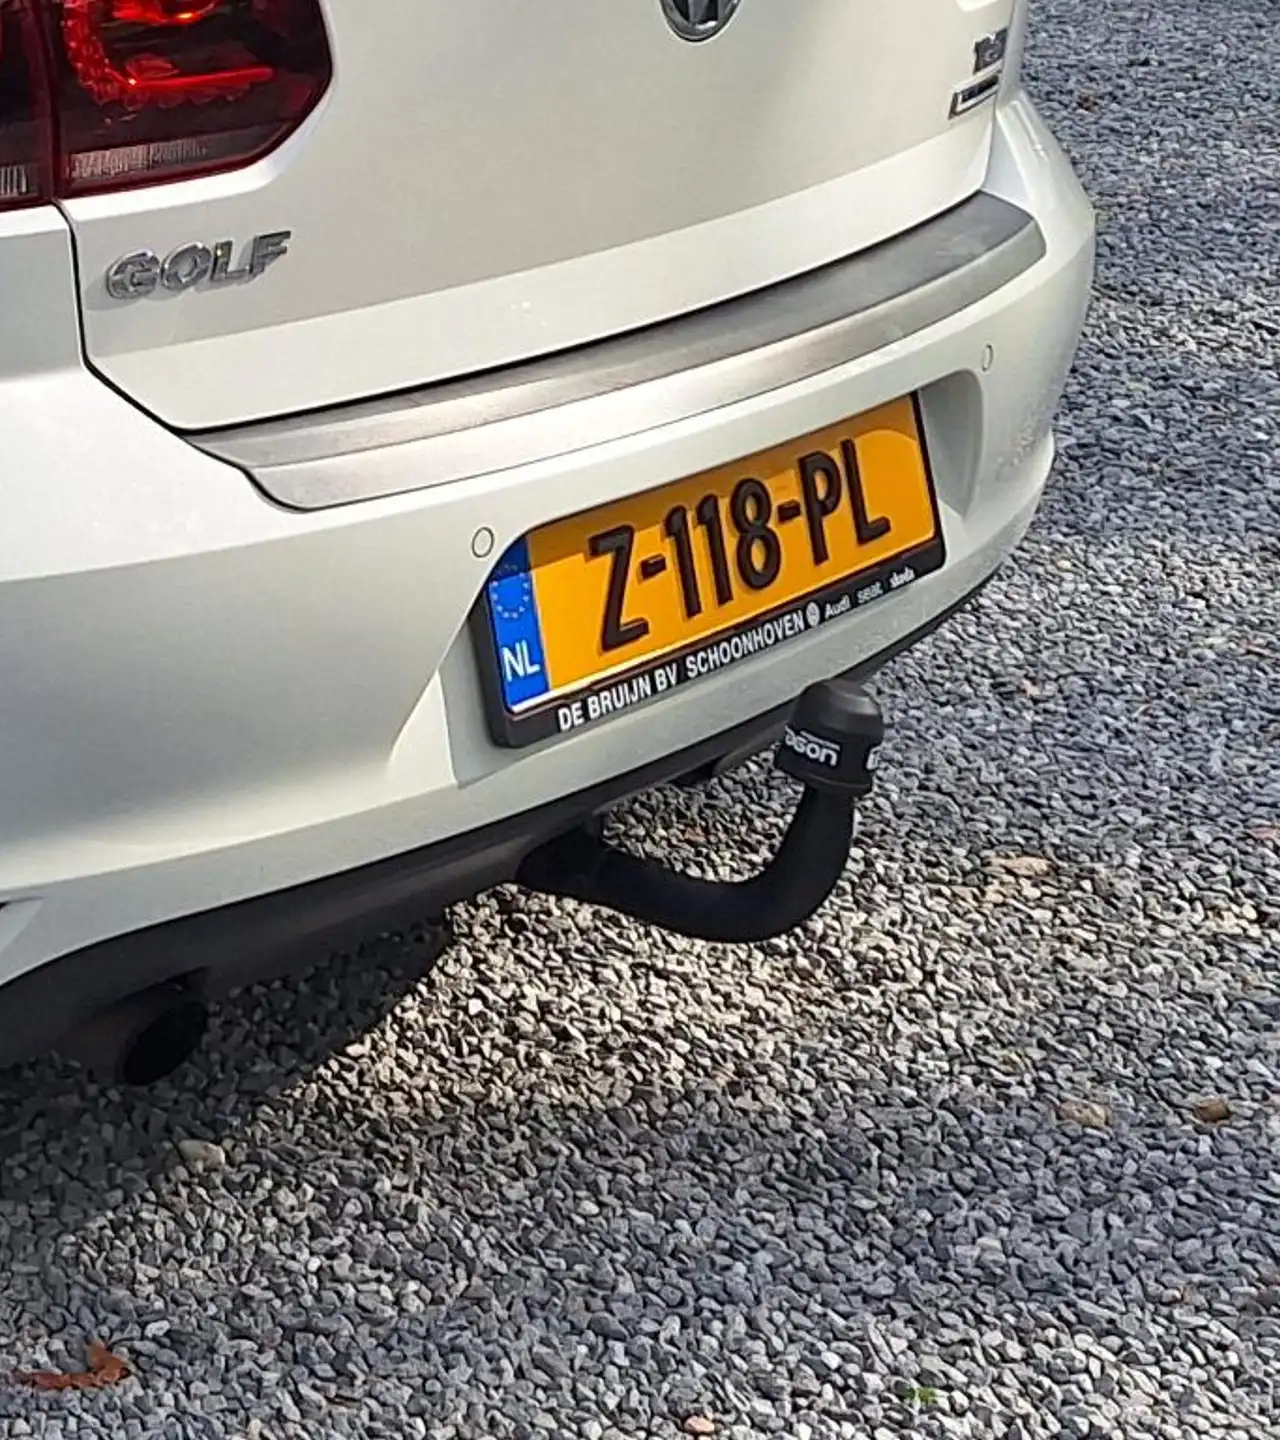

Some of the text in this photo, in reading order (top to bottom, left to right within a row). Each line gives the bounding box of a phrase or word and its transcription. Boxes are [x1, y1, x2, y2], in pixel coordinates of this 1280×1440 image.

[107, 230, 292, 299] GOLF
[588, 438, 891, 653] Z-118-PL
[502, 642, 541, 681] NL
[558, 703, 584, 731] DE
[587, 676, 651, 715] BRUIJN
[654, 665, 678, 692] BV
[686, 609, 805, 679] SCHOONHOVEN
